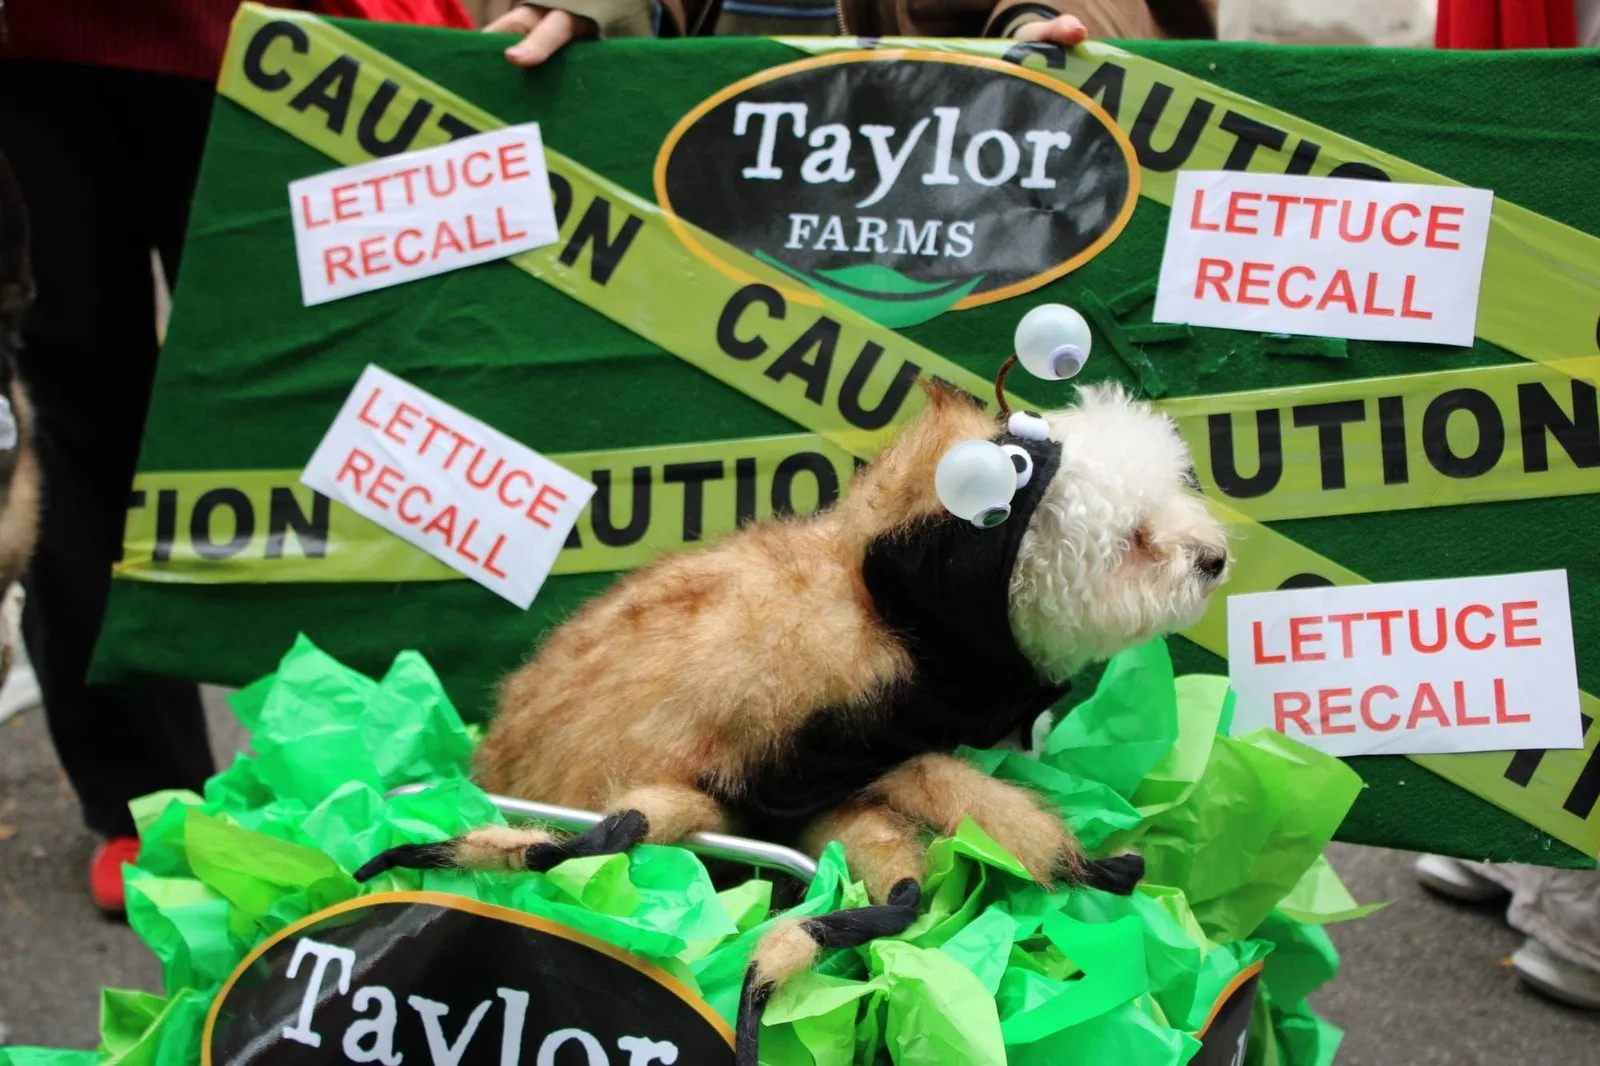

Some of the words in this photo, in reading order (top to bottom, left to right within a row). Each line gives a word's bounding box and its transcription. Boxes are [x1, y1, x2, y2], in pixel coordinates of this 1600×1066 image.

[301, 141, 530, 229] LETTUCE
[733, 102, 1072, 208] Taylor
[243, 20, 643, 287] CAUN
[716, 283, 989, 431] CAU
[323, 207, 527, 285] RECALL
[785, 213, 976, 258] FARMS
[1190, 188, 1465, 251] LETTUCE
[1194, 256, 1433, 320] RECALL
[356, 387, 568, 529] LETTUCE
[130, 487, 332, 562] ION
[336, 448, 508, 579] RECALL
[1252, 600, 1542, 665] LETTUCE
[1273, 678, 1531, 737] RECALL
